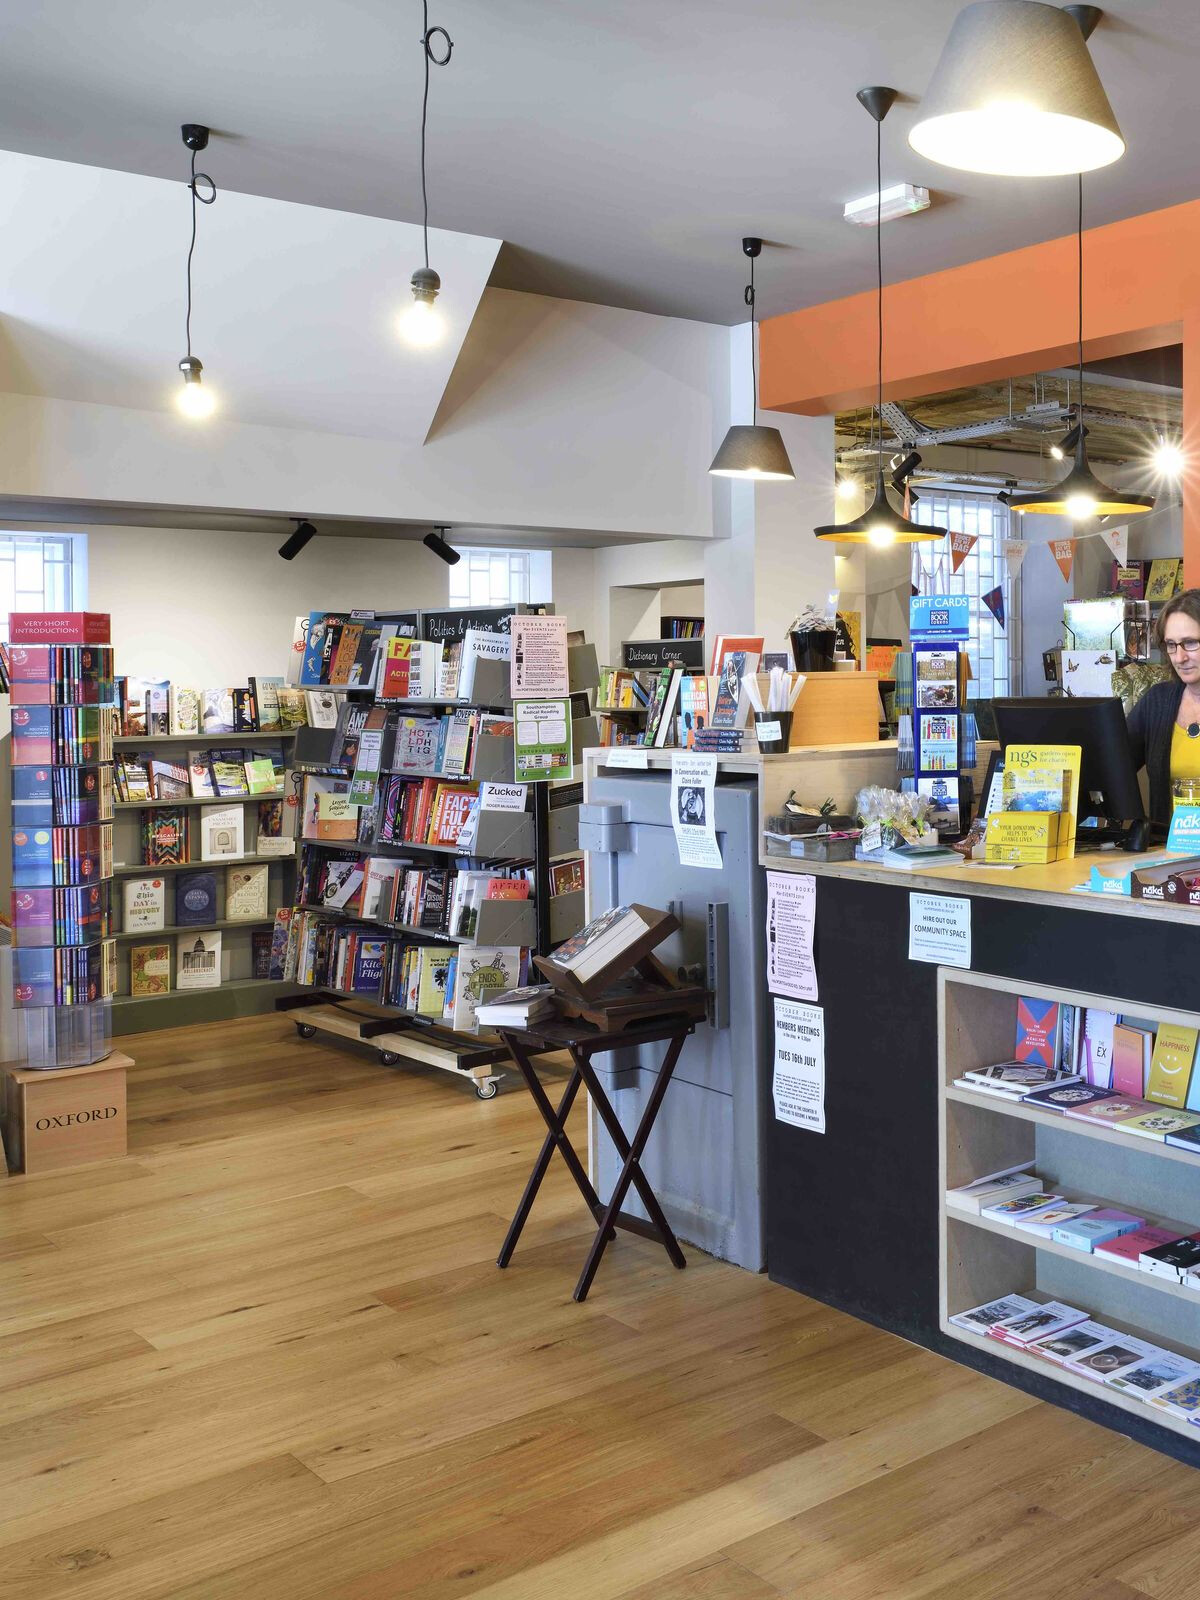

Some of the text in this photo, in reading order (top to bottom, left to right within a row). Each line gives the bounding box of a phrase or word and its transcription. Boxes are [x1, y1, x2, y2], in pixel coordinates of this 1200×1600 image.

[952, 544, 969, 553] BAG
[1056, 550, 1072, 559] BAG
[912, 597, 967, 608] GIFT CARDS
[429, 618, 455, 638] Politics
[472, 643, 510, 655] SAVAGERY
[628, 648, 682, 665] Dictionary Corner
[408, 729, 432, 738] HOT
[408, 746, 431, 754] TIG
[678, 768, 700, 776] Conversation
[488, 786, 522, 796] Zucked
[442, 810, 464, 826] FUL
[492, 882, 526, 890] AFTER
[769, 882, 814, 894] OCTOBER BOOKS
[136, 892, 154, 900] This
[134, 900, 150, 908] DAY
[130, 906, 160, 916] HISTORY
[922, 915, 935, 923] HIRE
[914, 924, 966, 938] COMMUNITY SPACE
[362, 960, 381, 968] Kite
[478, 972, 496, 982] ENDS
[776, 1006, 820, 1020] OCTOBER BOOKS
[776, 1020, 820, 1037] MEMBERS MEETINGS
[1160, 1040, 1190, 1052] HAPPINESS
[1096, 1046, 1107, 1058] EX
[778, 1050, 816, 1068] TUES 16th JULY
[36, 1106, 118, 1130] OXFORD
